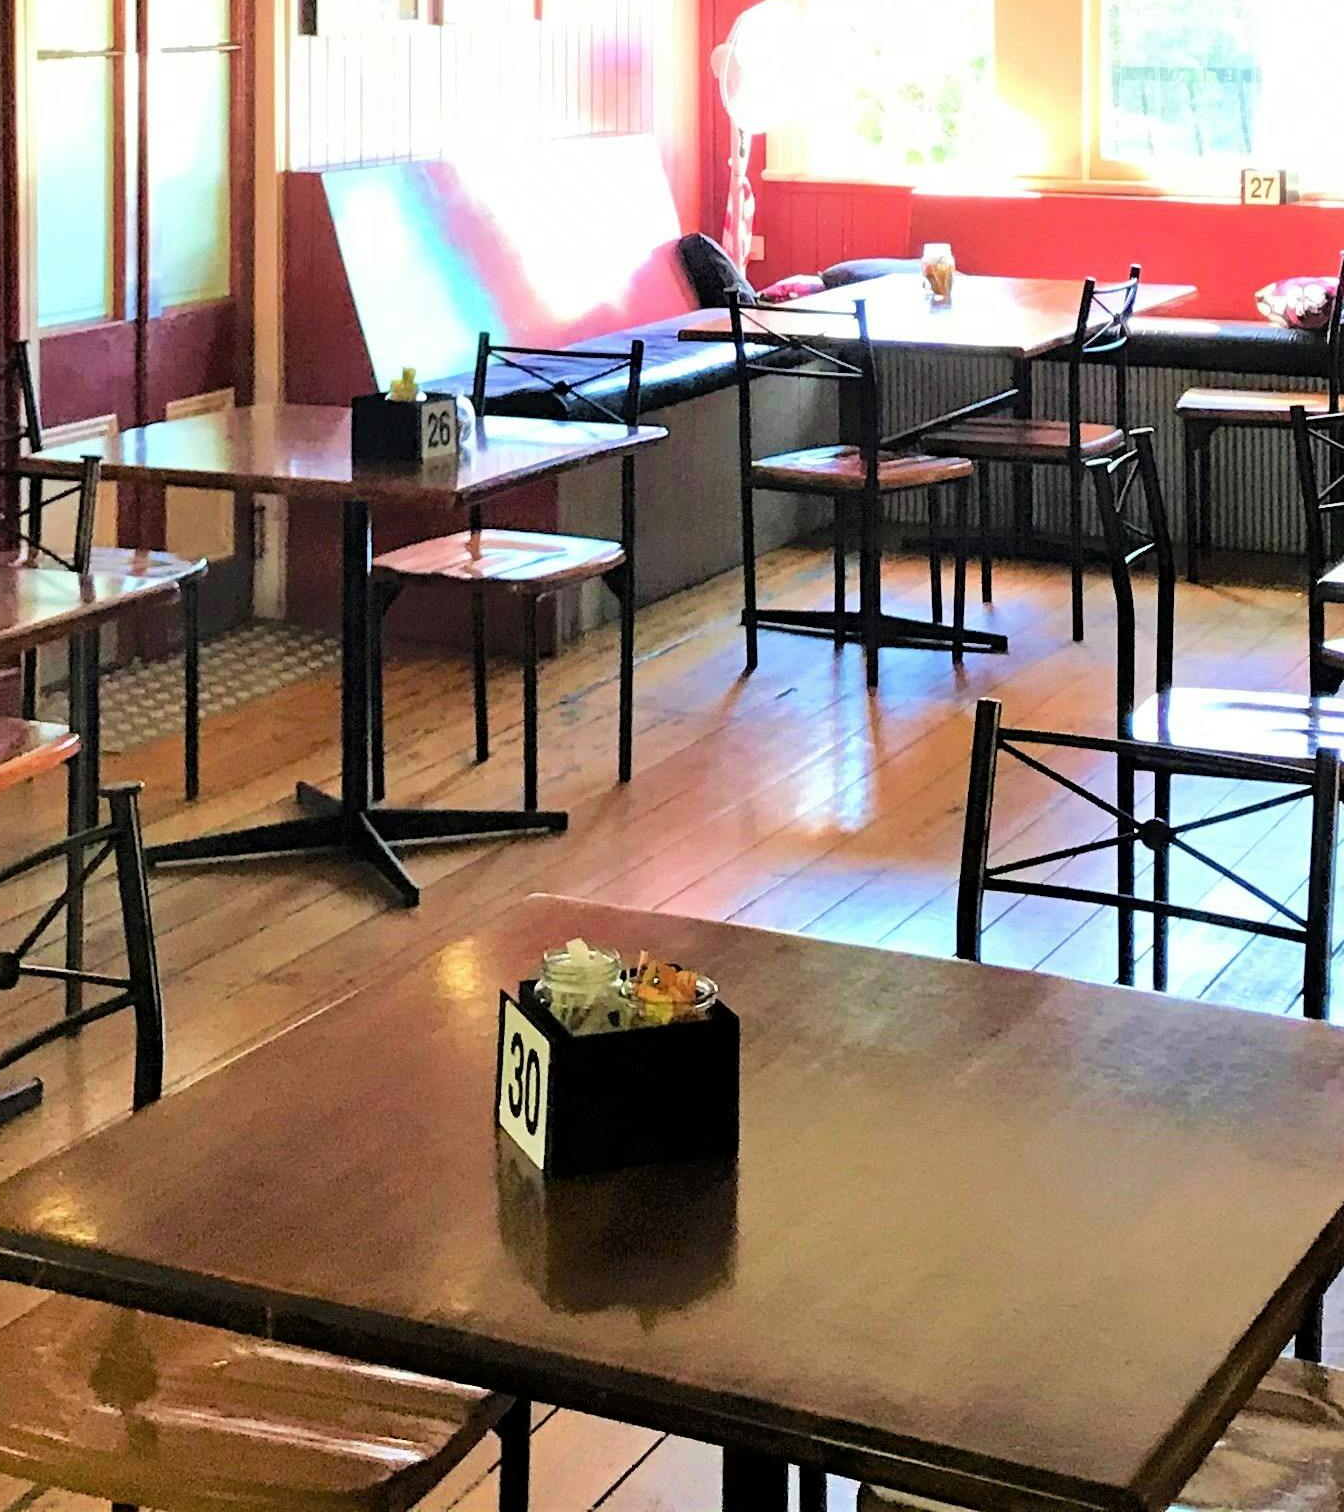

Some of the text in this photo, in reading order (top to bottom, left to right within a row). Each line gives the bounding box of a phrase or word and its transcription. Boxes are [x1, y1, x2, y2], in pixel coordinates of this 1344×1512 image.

[1251, 177, 1274, 199] 27
[428, 411, 450, 448] 26
[509, 1032, 540, 1136] 30
